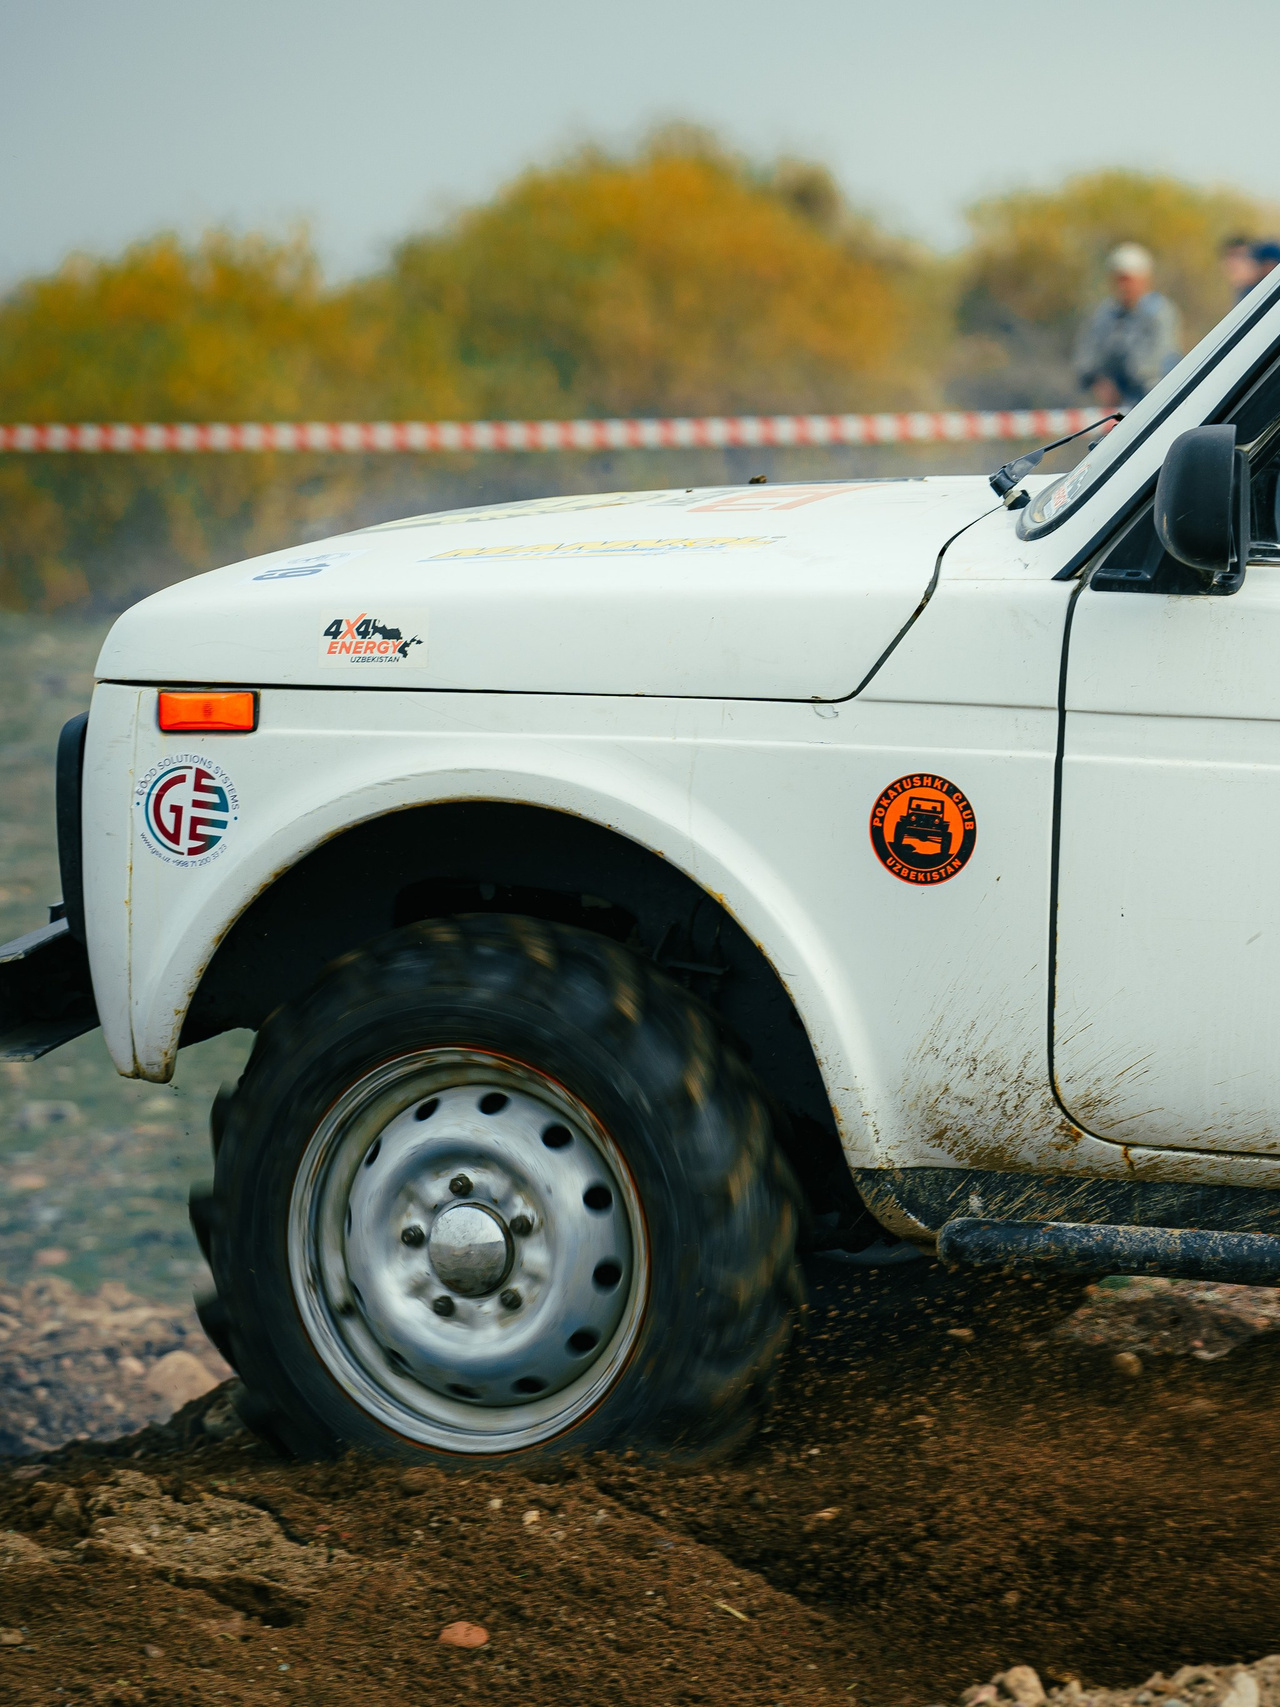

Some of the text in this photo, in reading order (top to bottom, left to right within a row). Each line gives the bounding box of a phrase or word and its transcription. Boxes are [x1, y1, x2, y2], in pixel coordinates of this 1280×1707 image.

[326, 640, 404, 655] ENERGY
[135, 754, 240, 811] GOOD SOLUTIONS SYSTEMS
[872, 776, 975, 830] POKATUSHKI CLUB
[886, 856, 962, 882] UZBEKISTAN
